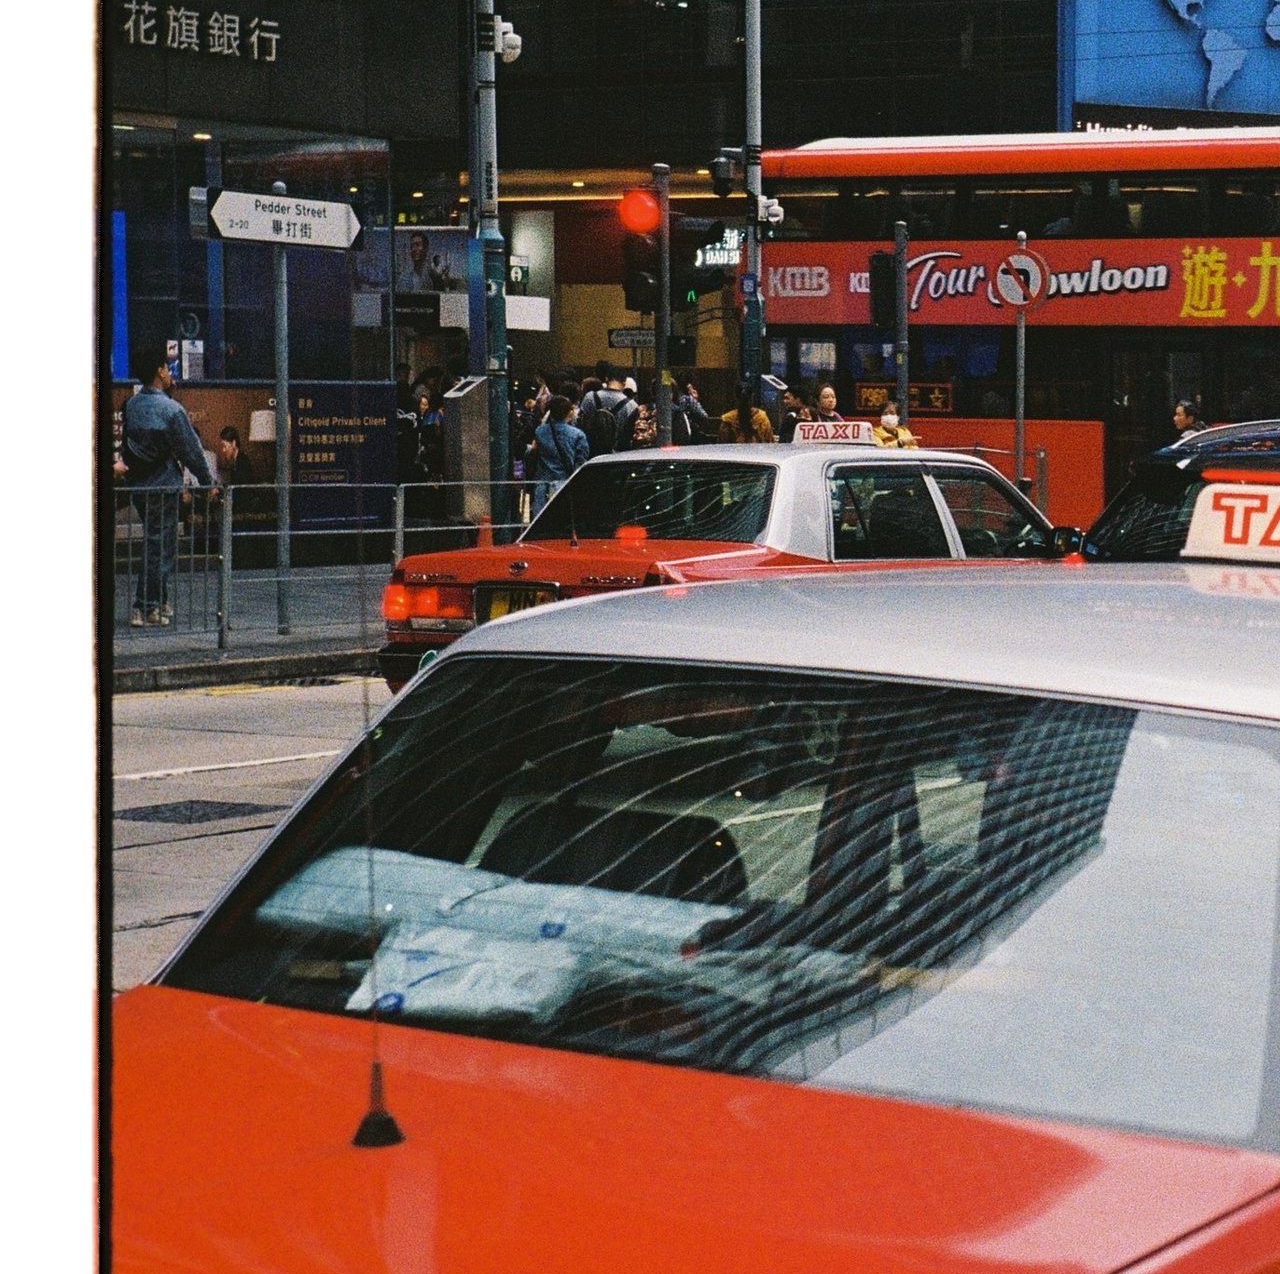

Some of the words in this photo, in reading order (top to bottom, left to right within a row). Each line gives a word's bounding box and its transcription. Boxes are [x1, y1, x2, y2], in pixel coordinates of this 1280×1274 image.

[124, 0, 281, 62] 花旗銀行
[254, 199, 290, 215] Pedder
[295, 203, 328, 218] Street
[767, 265, 831, 298] KMB
[906, 250, 986, 311] Tour
[363, 415, 387, 426] Client
[799, 423, 861, 440] TAXI
